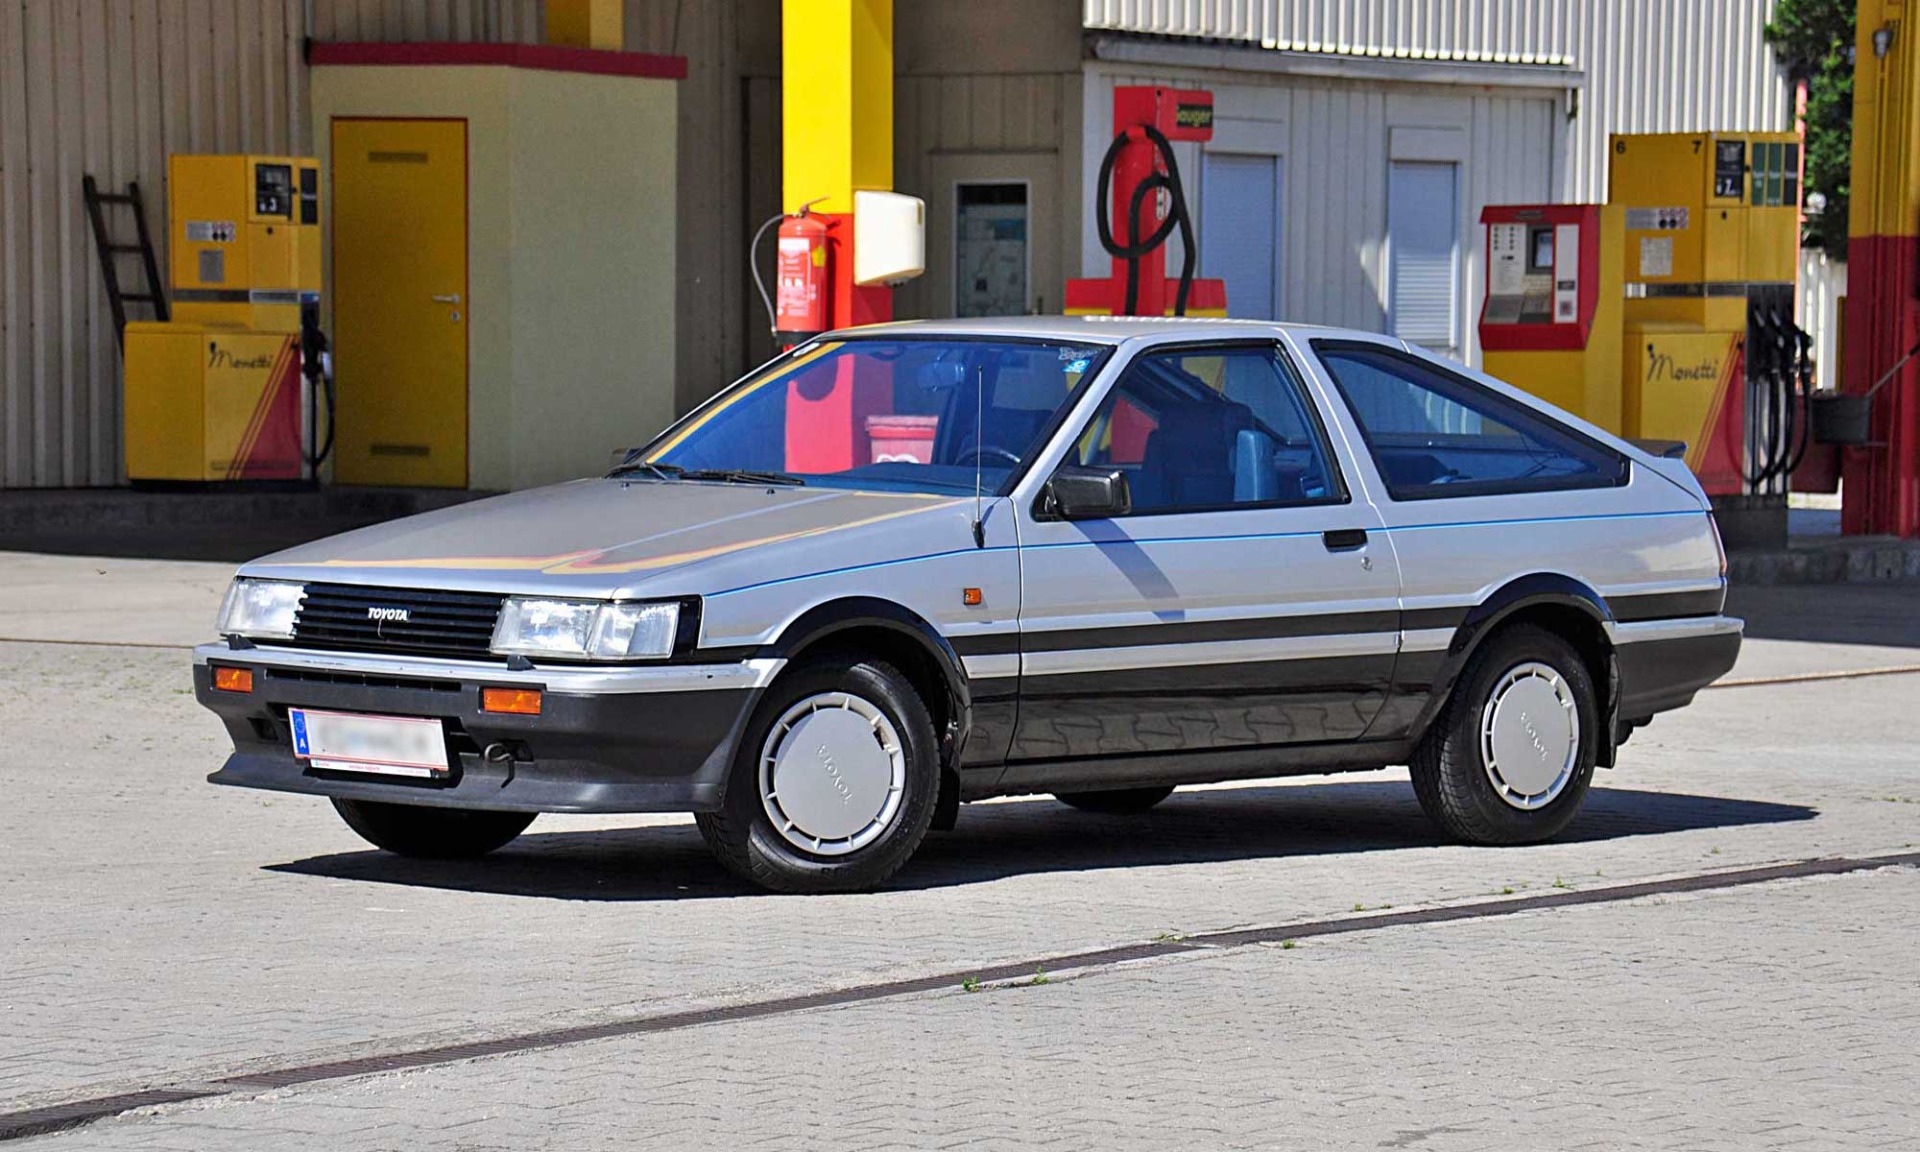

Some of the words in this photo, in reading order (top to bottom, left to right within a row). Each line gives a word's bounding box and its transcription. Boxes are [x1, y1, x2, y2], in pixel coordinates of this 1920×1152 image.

[1616, 140, 1626, 154] 6
[1691, 140, 1702, 154] 7
[1647, 351, 1719, 381] Monetti
[368, 607, 408, 621] TOYOTA
[299, 738, 306, 748] A
[1520, 711, 1549, 761] TOYOTA
[818, 743, 853, 805] TOYOTA
